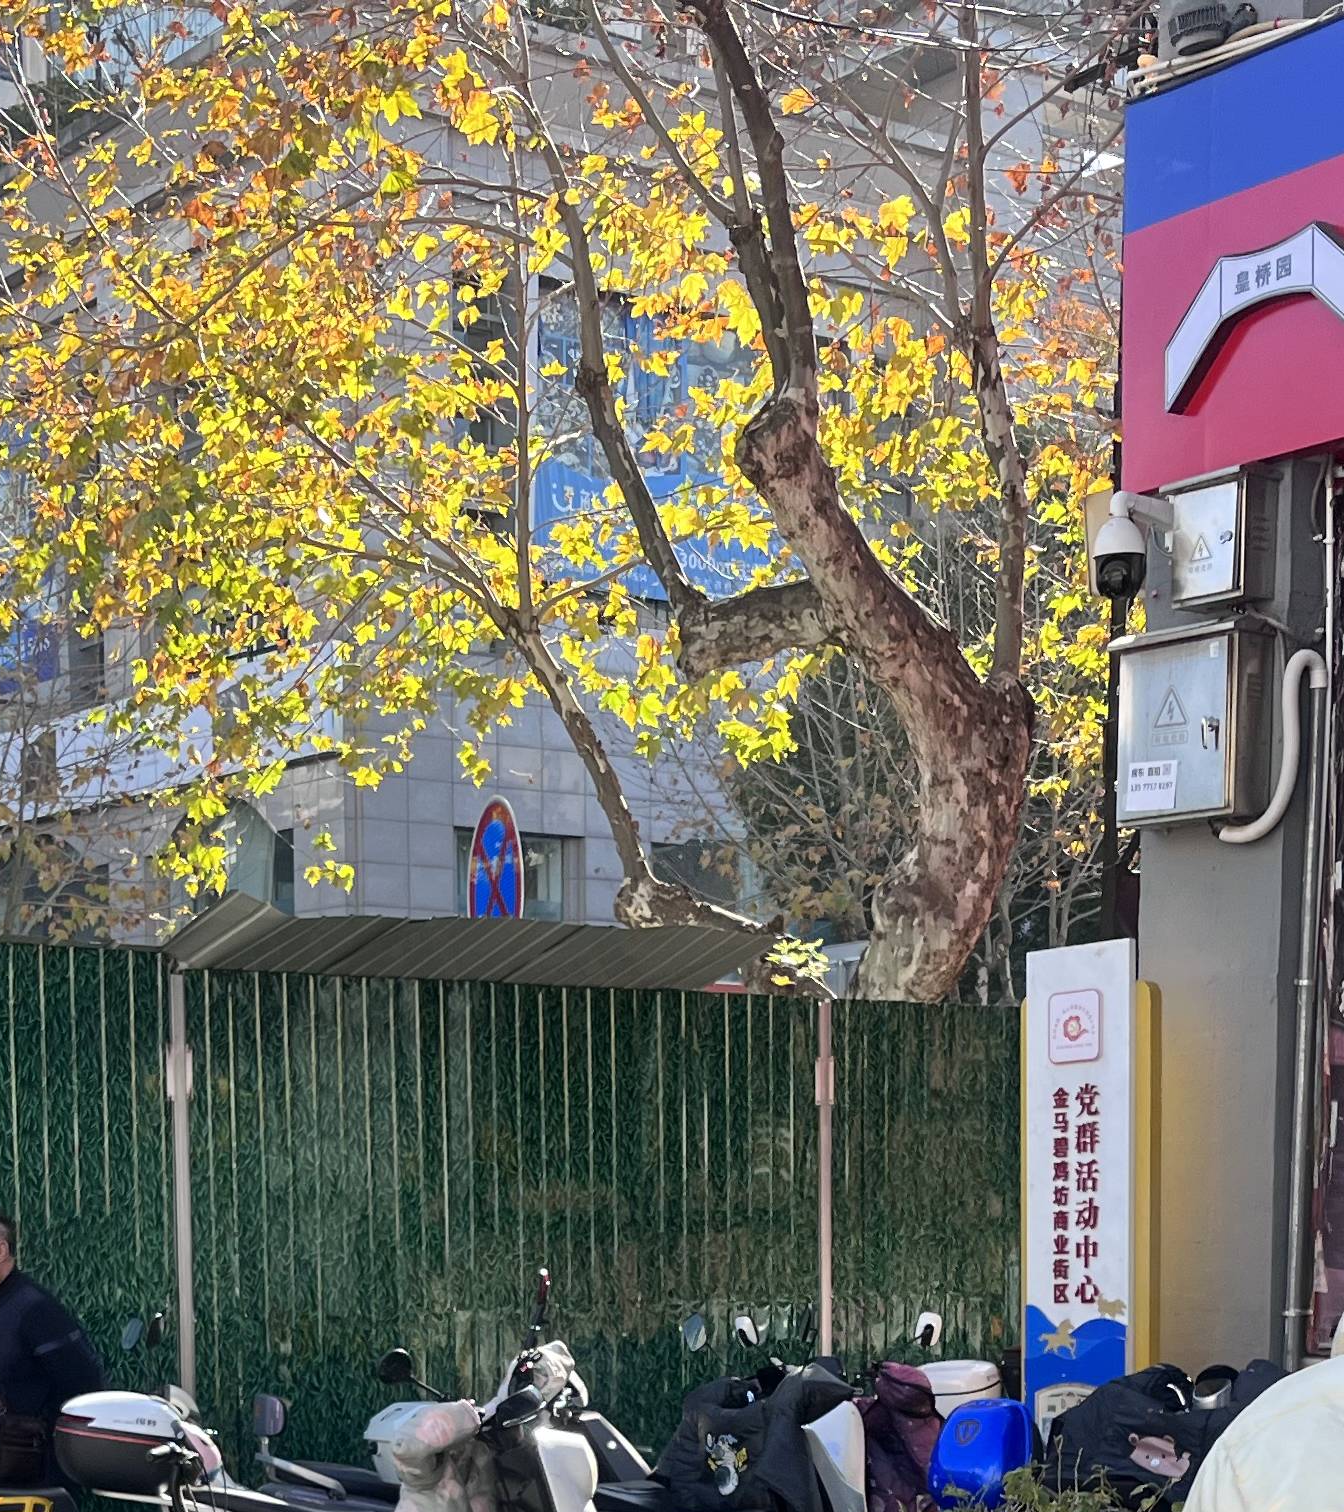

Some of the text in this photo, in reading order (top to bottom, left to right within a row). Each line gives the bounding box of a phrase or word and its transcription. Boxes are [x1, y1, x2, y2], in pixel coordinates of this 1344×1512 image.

[1053, 1087, 1070, 1304] 金马碧鸡坊商业街区
[1075, 1083, 1100, 1304] 党群活动中心
